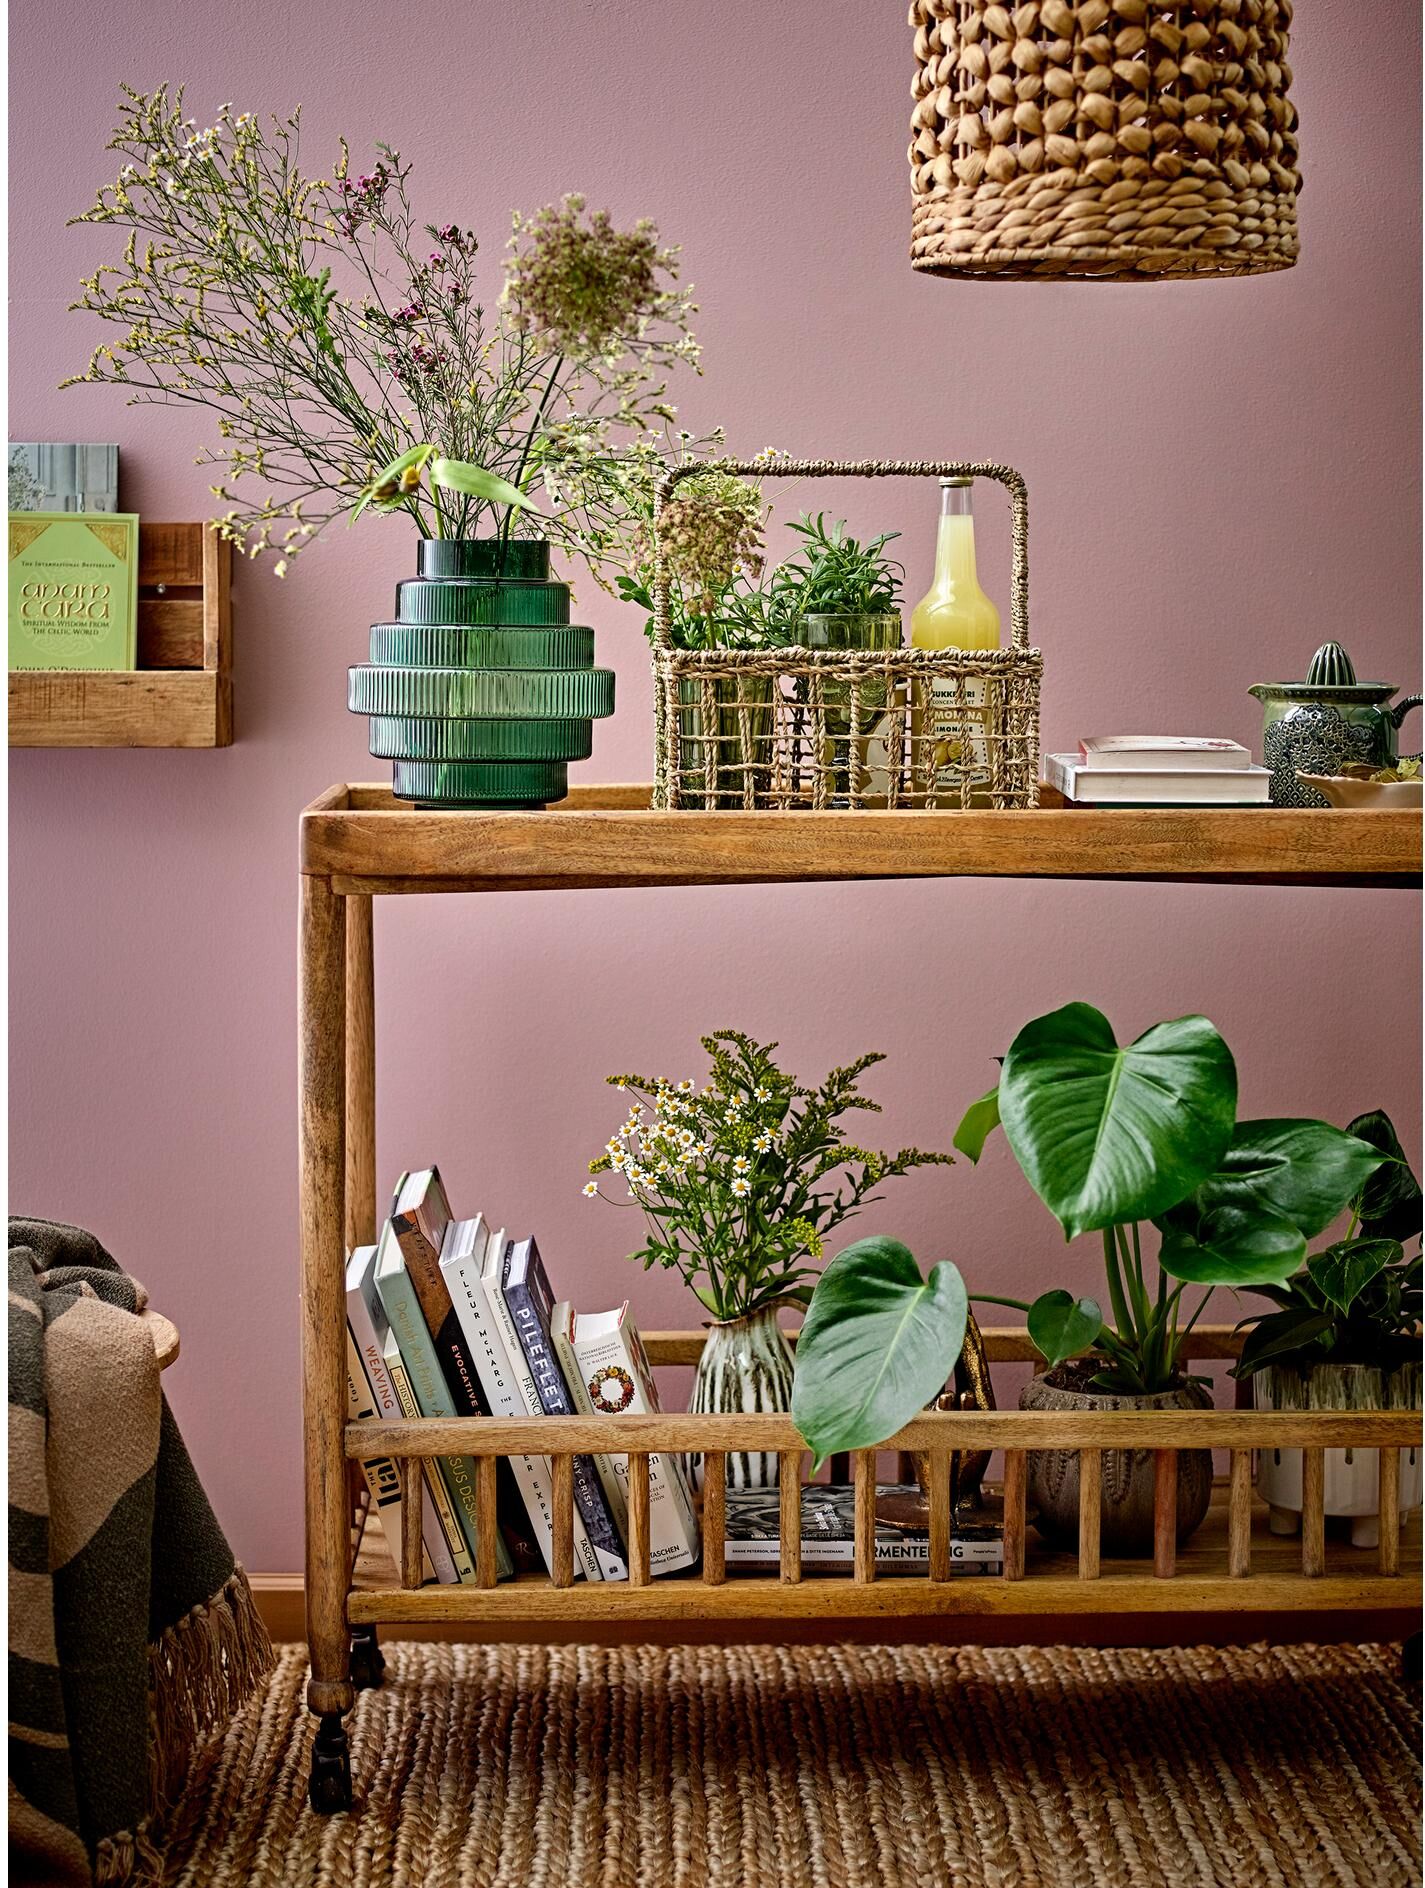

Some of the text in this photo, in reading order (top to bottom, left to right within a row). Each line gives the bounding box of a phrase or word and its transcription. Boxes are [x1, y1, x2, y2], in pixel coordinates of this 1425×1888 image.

[22, 619, 55, 627] SPIRITUAL
[57, 620, 88, 628] WISDOM
[72, 628, 99, 636] WORLD
[459, 1269, 481, 1319] FLEUR
[451, 1344, 478, 1407] EVOCATIVE
[517, 1307, 563, 1409] PILEFLET
[365, 1345, 394, 1410] WEAVING
[399, 1383, 416, 1418] HISTORY
[522, 1376, 543, 1417] FRANCI
[367, 1471, 376, 1486] THE
[578, 1478, 593, 1507] CRISP
[533, 1481, 552, 1531] EXPER
[580, 1538, 597, 1573] TASCHEN
[650, 1545, 680, 1558] TASCHEN
